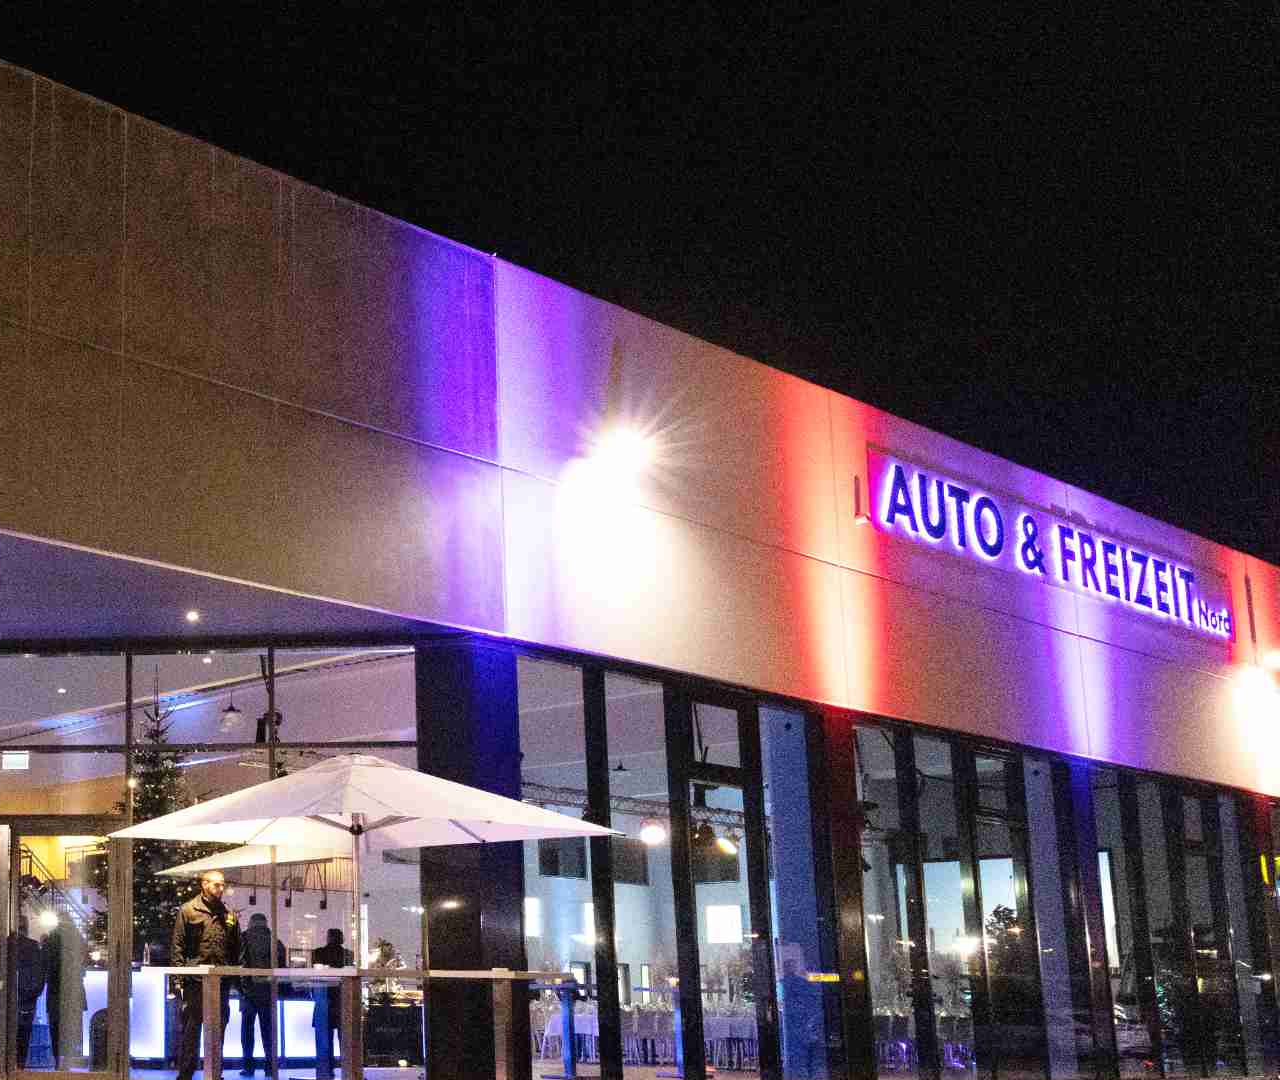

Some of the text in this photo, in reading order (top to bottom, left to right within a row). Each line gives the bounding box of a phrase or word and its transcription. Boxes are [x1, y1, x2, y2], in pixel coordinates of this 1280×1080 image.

[885, 463, 1004, 558] AUTO
[1019, 514, 1046, 575] &
[1057, 525, 1195, 623] FREIZEIT
